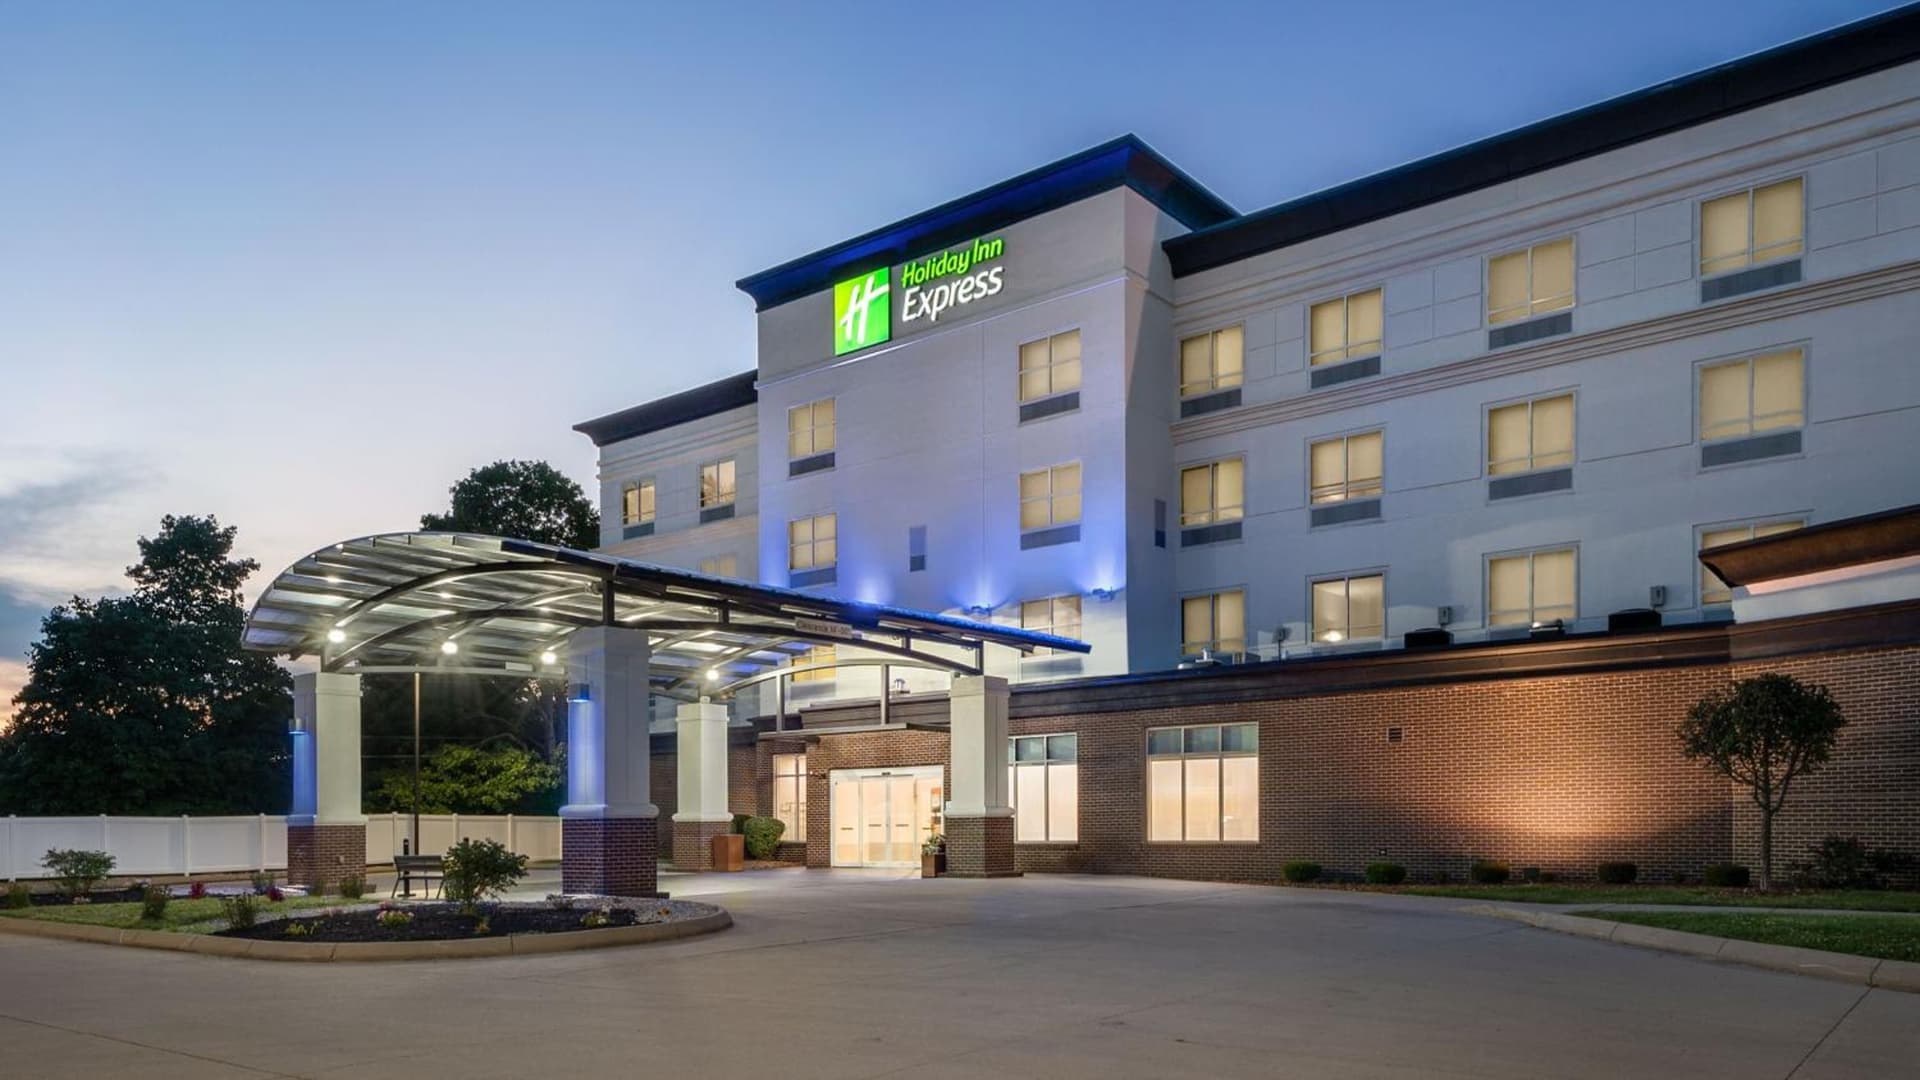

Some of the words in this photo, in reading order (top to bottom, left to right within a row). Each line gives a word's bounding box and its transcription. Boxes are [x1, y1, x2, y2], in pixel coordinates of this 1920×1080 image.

[902, 250, 969, 288] Holiday
[972, 238, 1003, 264] Inn
[902, 266, 1003, 322] Express
